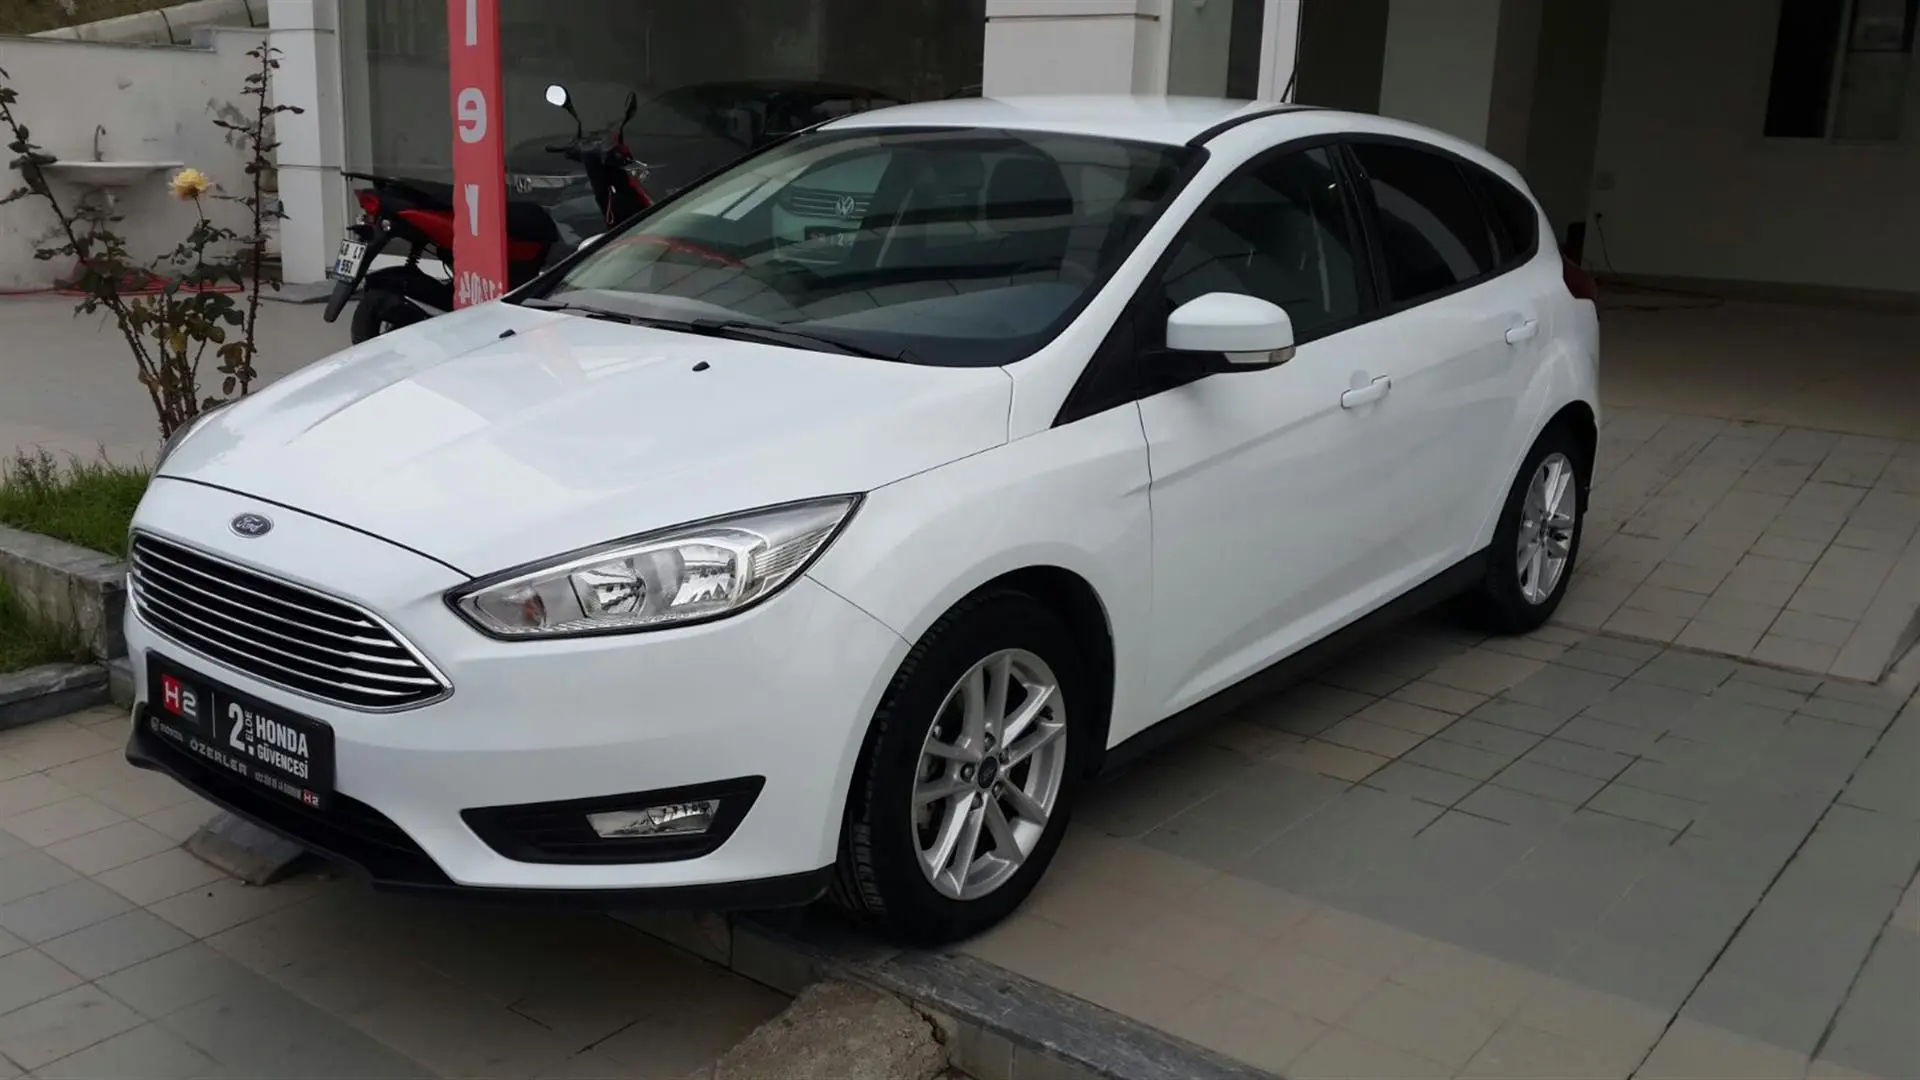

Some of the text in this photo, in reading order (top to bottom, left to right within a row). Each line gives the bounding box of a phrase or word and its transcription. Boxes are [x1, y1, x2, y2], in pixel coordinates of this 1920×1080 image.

[236, 516, 264, 533] Ford
[162, 680, 198, 718] H2
[256, 714, 309, 758] HONDA
[189, 738, 248, 776] ÖZERLER
[257, 744, 309, 780] GÜVENCESİ
